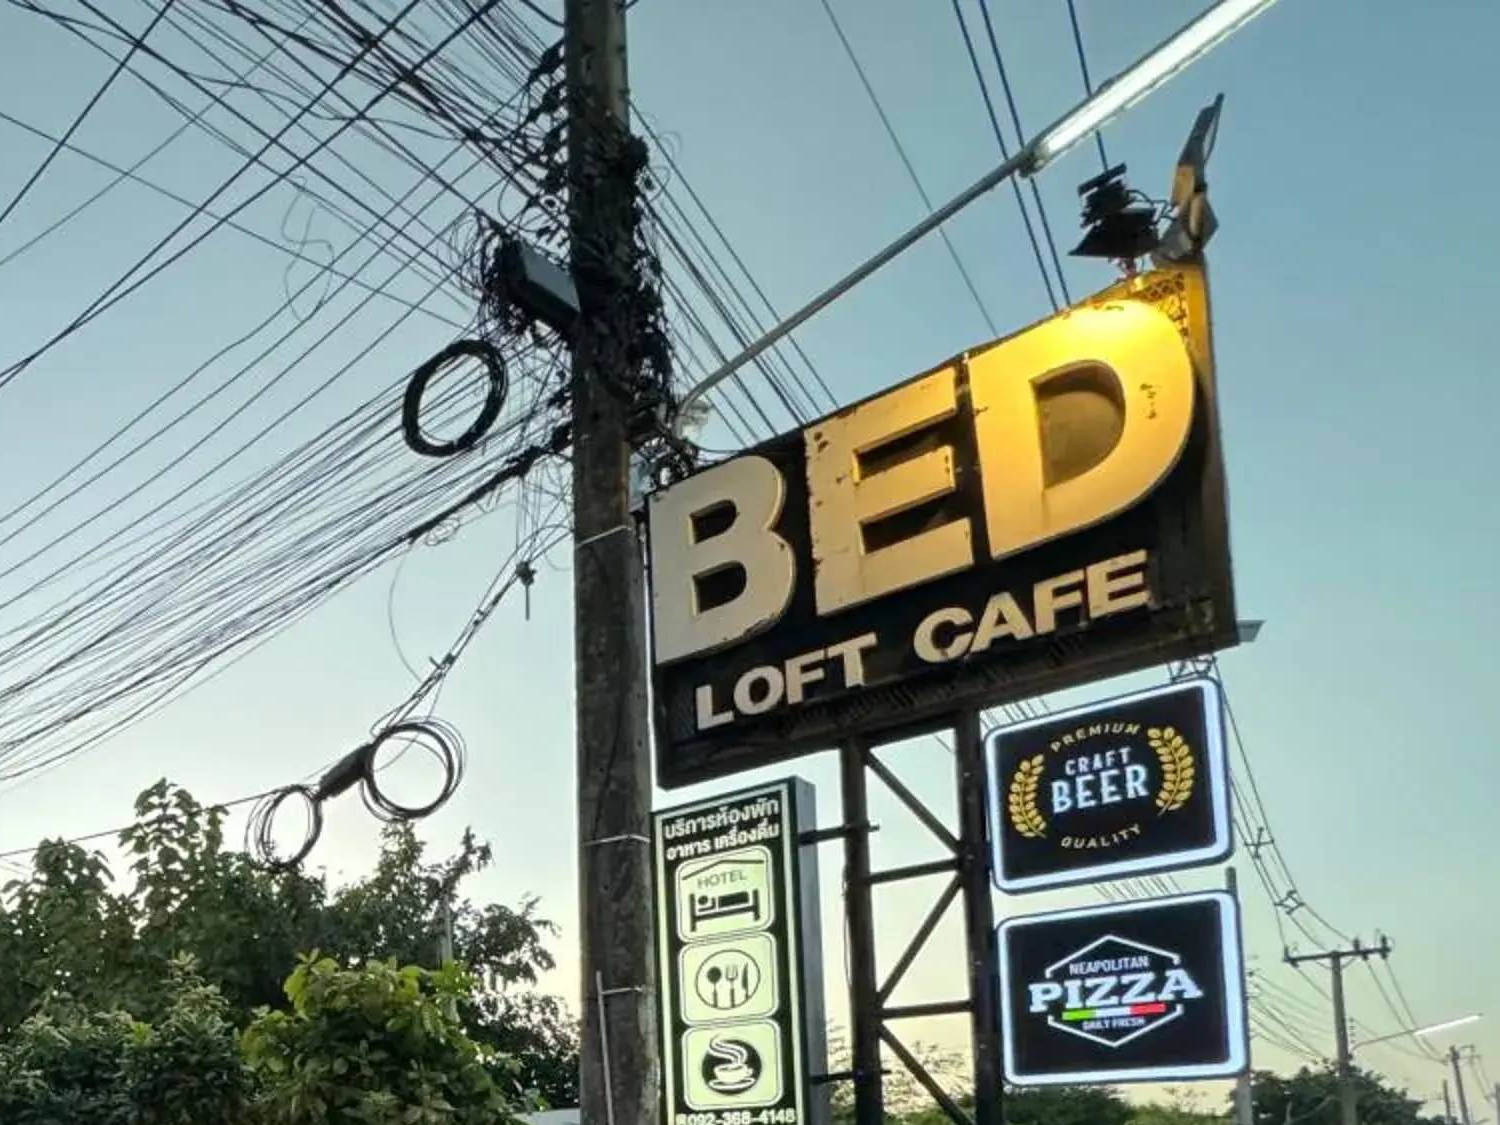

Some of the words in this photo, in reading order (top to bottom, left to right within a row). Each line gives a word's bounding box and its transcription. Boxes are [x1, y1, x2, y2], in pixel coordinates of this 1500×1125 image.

[646, 299, 1195, 665] BED
[696, 632, 879, 729] LOFT
[913, 549, 1152, 664] CAFE
[1050, 722, 1142, 753] PREMIUM
[1065, 746, 1131, 776] CRAFT
[1051, 763, 1149, 814] BEER
[664, 798, 780, 840] บริการห้องพัก
[666, 839, 711, 861] อาหาร
[1061, 823, 1141, 849] QUALITY
[697, 870, 749, 889] HOTEL
[1069, 955, 1149, 976] NEAPOLITAN
[1027, 968, 1204, 1013] PIZZA
